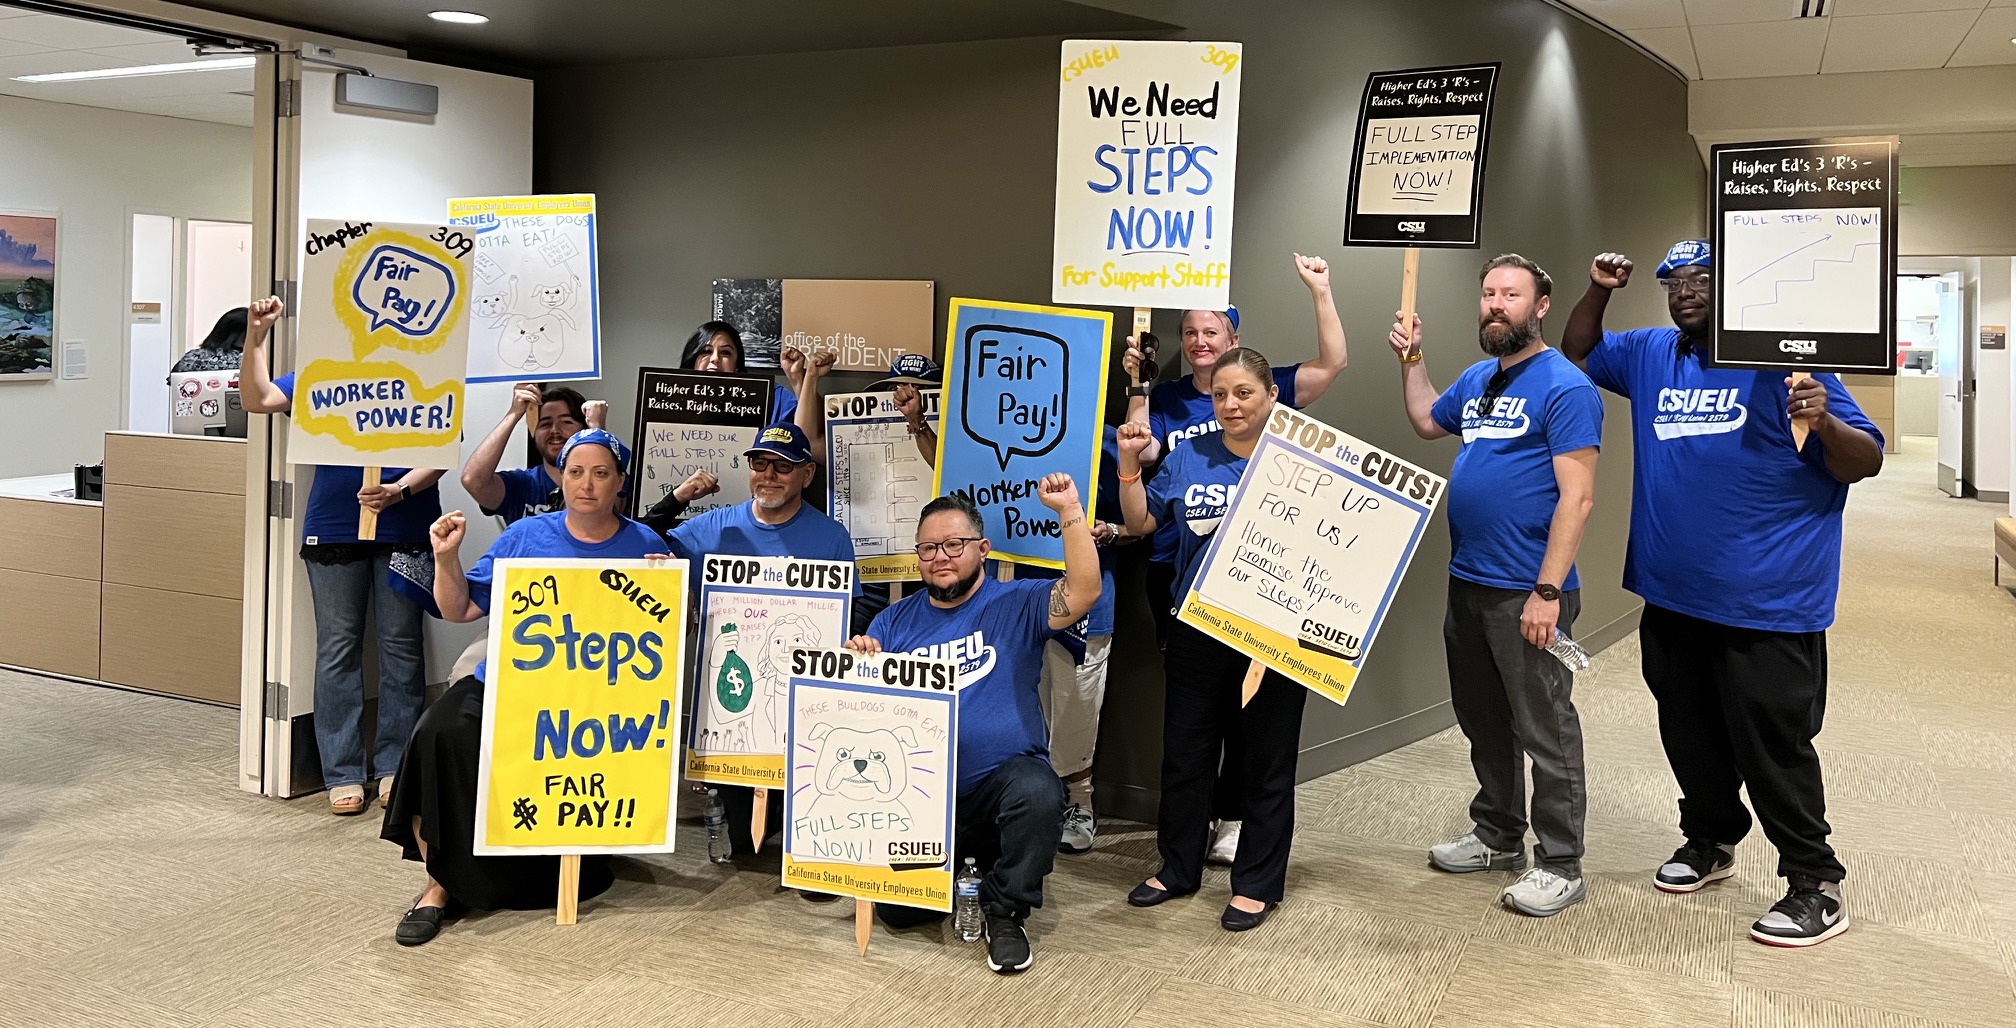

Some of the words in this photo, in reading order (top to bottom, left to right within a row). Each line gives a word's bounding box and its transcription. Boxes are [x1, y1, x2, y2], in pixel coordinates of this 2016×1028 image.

[1063, 44, 1120, 82] CSUEU
[1200, 44, 1239, 76] 309
[1380, 79, 1414, 95] Higher
[1416, 78, 1437, 90] Ed's
[1440, 78, 1448, 88] 3
[1445, 91, 1483, 105] Respect
[1088, 85, 1141, 118] We
[1146, 81, 1219, 119] Need
[1121, 120, 1194, 145] FULL
[1371, 126, 1426, 144] FULL
[1431, 124, 1477, 141] STEP
[1087, 144, 1218, 195] STEPS
[1366, 150, 1476, 166] IMPLEMENTATION
[1732, 159, 1777, 178] Higher
[1781, 157, 1810, 173] Ed's
[1815, 157, 1825, 171] 3
[1393, 169, 1453, 191] NOW!
[1826, 176, 1882, 195] Respect
[502, 215, 545, 228] THESE
[556, 215, 590, 228] DOGS
[1107, 206, 1212, 250] NOW!
[1733, 215, 1769, 226] FULL
[1781, 214, 1823, 223] STEPS
[1836, 213, 1878, 230] NOW!
[305, 222, 373, 255] chapter
[429, 227, 473, 259] 309
[479, 235, 511, 248] OTTA
[523, 228, 555, 247] EAT!
[373, 256, 420, 282] Fair
[1062, 264, 1097, 288] For
[1099, 261, 1170, 292] Support
[1171, 262, 1230, 289] Staff
[381, 287, 436, 327] Pay!
[784, 332, 822, 346] office
[825, 332, 840, 347] of
[843, 333, 866, 348] the
[900, 359, 924, 368] FIGHT
[978, 339, 1047, 381] Fair
[312, 380, 405, 411] WORKER
[655, 382, 690, 397] Higher
[694, 384, 715, 396] Ed's
[718, 386, 725, 396] 3
[1658, 387, 1739, 414] CSUEU
[356, 394, 453, 431] POWER!
[724, 401, 761, 417] Respect
[827, 396, 878, 418] STOP
[998, 392, 1058, 444] Pay!
[1708, 413, 1729, 422] 2579
[652, 429, 674, 443] We
[681, 430, 713, 441] NEED
[718, 433, 739, 443] OUR
[1496, 420, 1514, 428] 2579
[648, 445, 679, 459] FULL
[1269, 409, 1337, 454] STOP
[1335, 444, 1360, 466] the
[1361, 451, 1442, 506] CUTS!
[1267, 453, 1333, 497] STEP
[1341, 488, 1380, 513] UP
[1186, 507, 1206, 517] CSEA
[1259, 492, 1301, 525] FOR
[1004, 506, 1062, 540] Powe
[1241, 520, 1291, 558] Honor
[1300, 555, 1332, 582] the
[705, 558, 761, 585] STOP
[763, 567, 783, 583] the
[785, 563, 850, 590] CUTS!
[862, 566, 878, 575] State
[880, 564, 910, 575] University
[1228, 566, 1252, 583] our
[512, 575, 559, 615] 309
[599, 569, 671, 623] CSUEU
[710, 597, 724, 607] HEY
[733, 597, 763, 605] MILLION
[770, 598, 797, 606] DOLLAR
[1302, 577, 1361, 614] Approve
[743, 608, 768, 619] OUR
[741, 622, 767, 632] RAISES
[1301, 618, 1360, 650] CSUEU
[512, 613, 663, 686] Steps
[1187, 602, 1221, 627] California
[1222, 620, 1243, 638] State
[1243, 631, 1282, 661] University
[1281, 652, 1322, 681] Employees
[1322, 673, 1345, 693] Union
[792, 649, 852, 680] STOP
[856, 658, 879, 679] the
[882, 657, 955, 691] CUTS!
[960, 660, 981, 674] 2579
[799, 701, 829, 719] THESE
[837, 700, 886, 712] BULLDOGS
[690, 760, 720, 773] California
[722, 763, 740, 775] State
[742, 765, 776, 781] University
[545, 773, 605, 798] FAIR
[557, 798, 635, 828] PAY!!
[795, 815, 844, 839] FULL
[847, 812, 910, 832] STEPS
[813, 838, 872, 862] NOW!
[888, 841, 942, 856] CSUEU
[787, 866, 821, 881] California
[823, 871, 842, 884] State
[845, 874, 880, 893] University
[884, 881, 923, 896] Employees
[926, 887, 947, 900] Union
